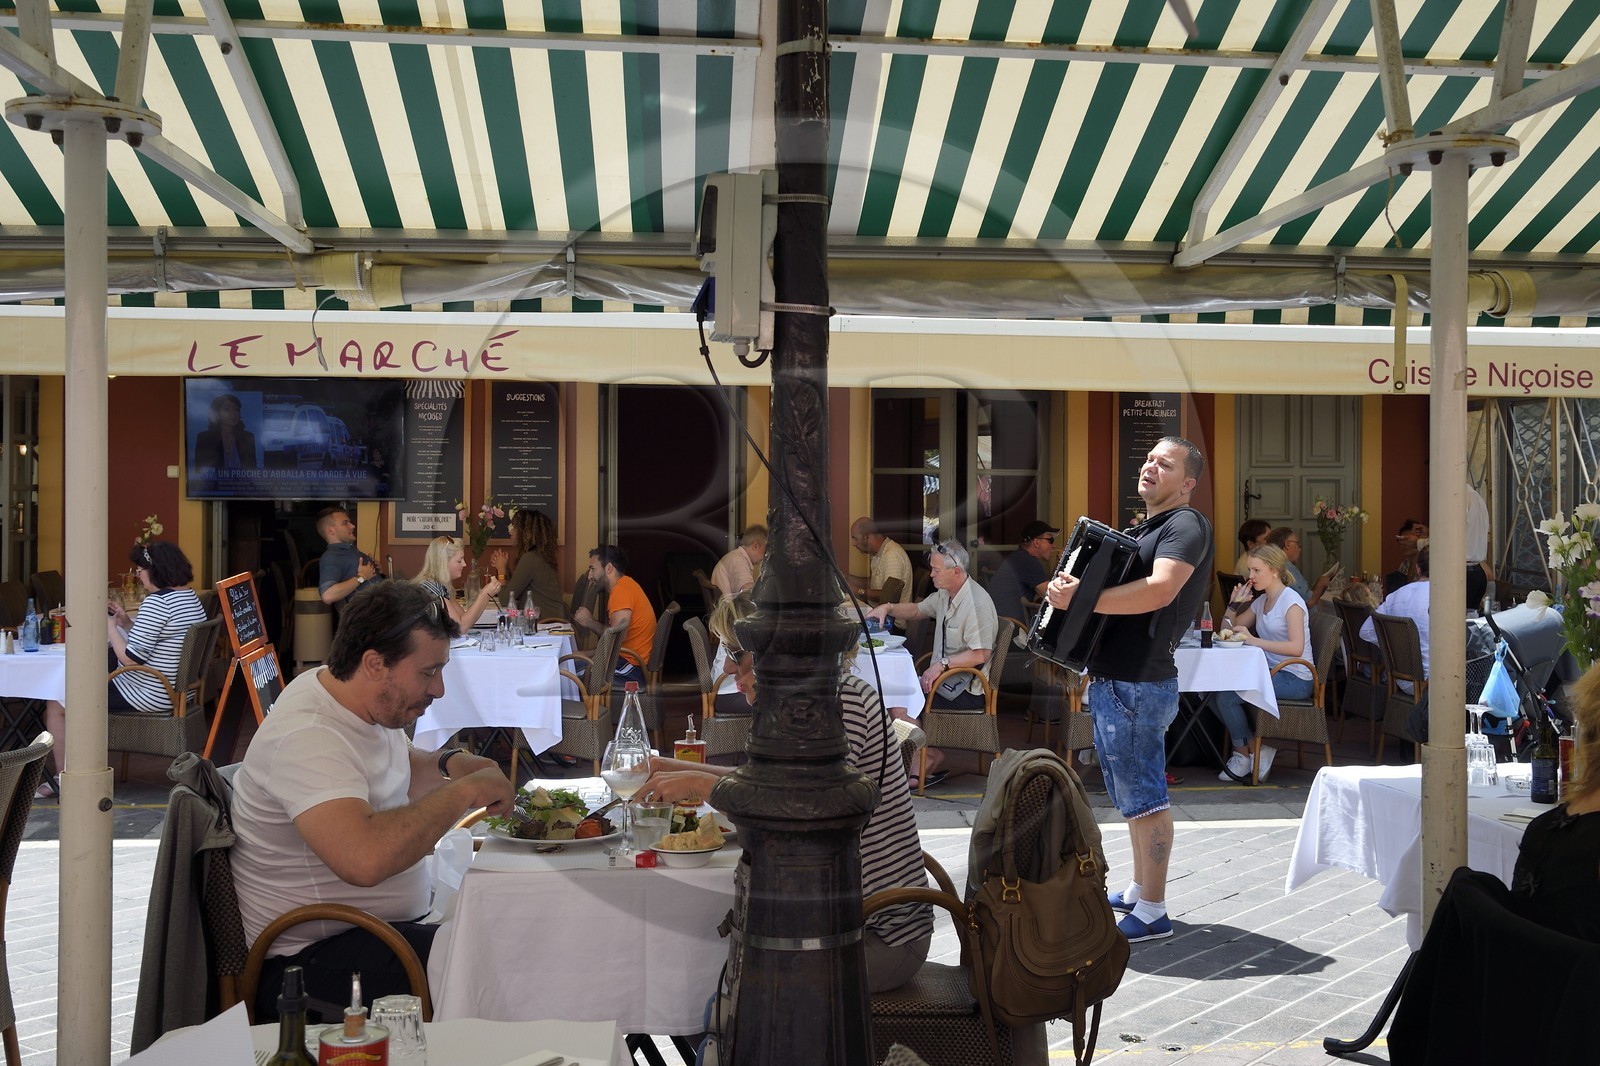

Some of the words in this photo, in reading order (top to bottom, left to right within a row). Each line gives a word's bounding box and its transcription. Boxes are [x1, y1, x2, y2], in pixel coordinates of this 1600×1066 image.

[187, 335, 264, 372] LE
[285, 330, 520, 373] MARCHÉ
[1368, 358, 1477, 386] Cise
[1489, 362, 1593, 394] Niçoise
[506, 393, 546, 402] SUGGESTIONS
[413, 402, 447, 411] SPÉCIALITÉS
[1134, 399, 1166, 408] BREAKFAST
[1123, 409, 1177, 418] PETITS-DÉJEUNERS
[218, 470, 230, 478] UN
[231, 470, 260, 478] PROCHE
[262, 470, 305, 478] D'ABBALLA
[306, 470, 317, 479] EN
[318, 470, 344, 479] GARDE
[352, 470, 368, 479] VUE
